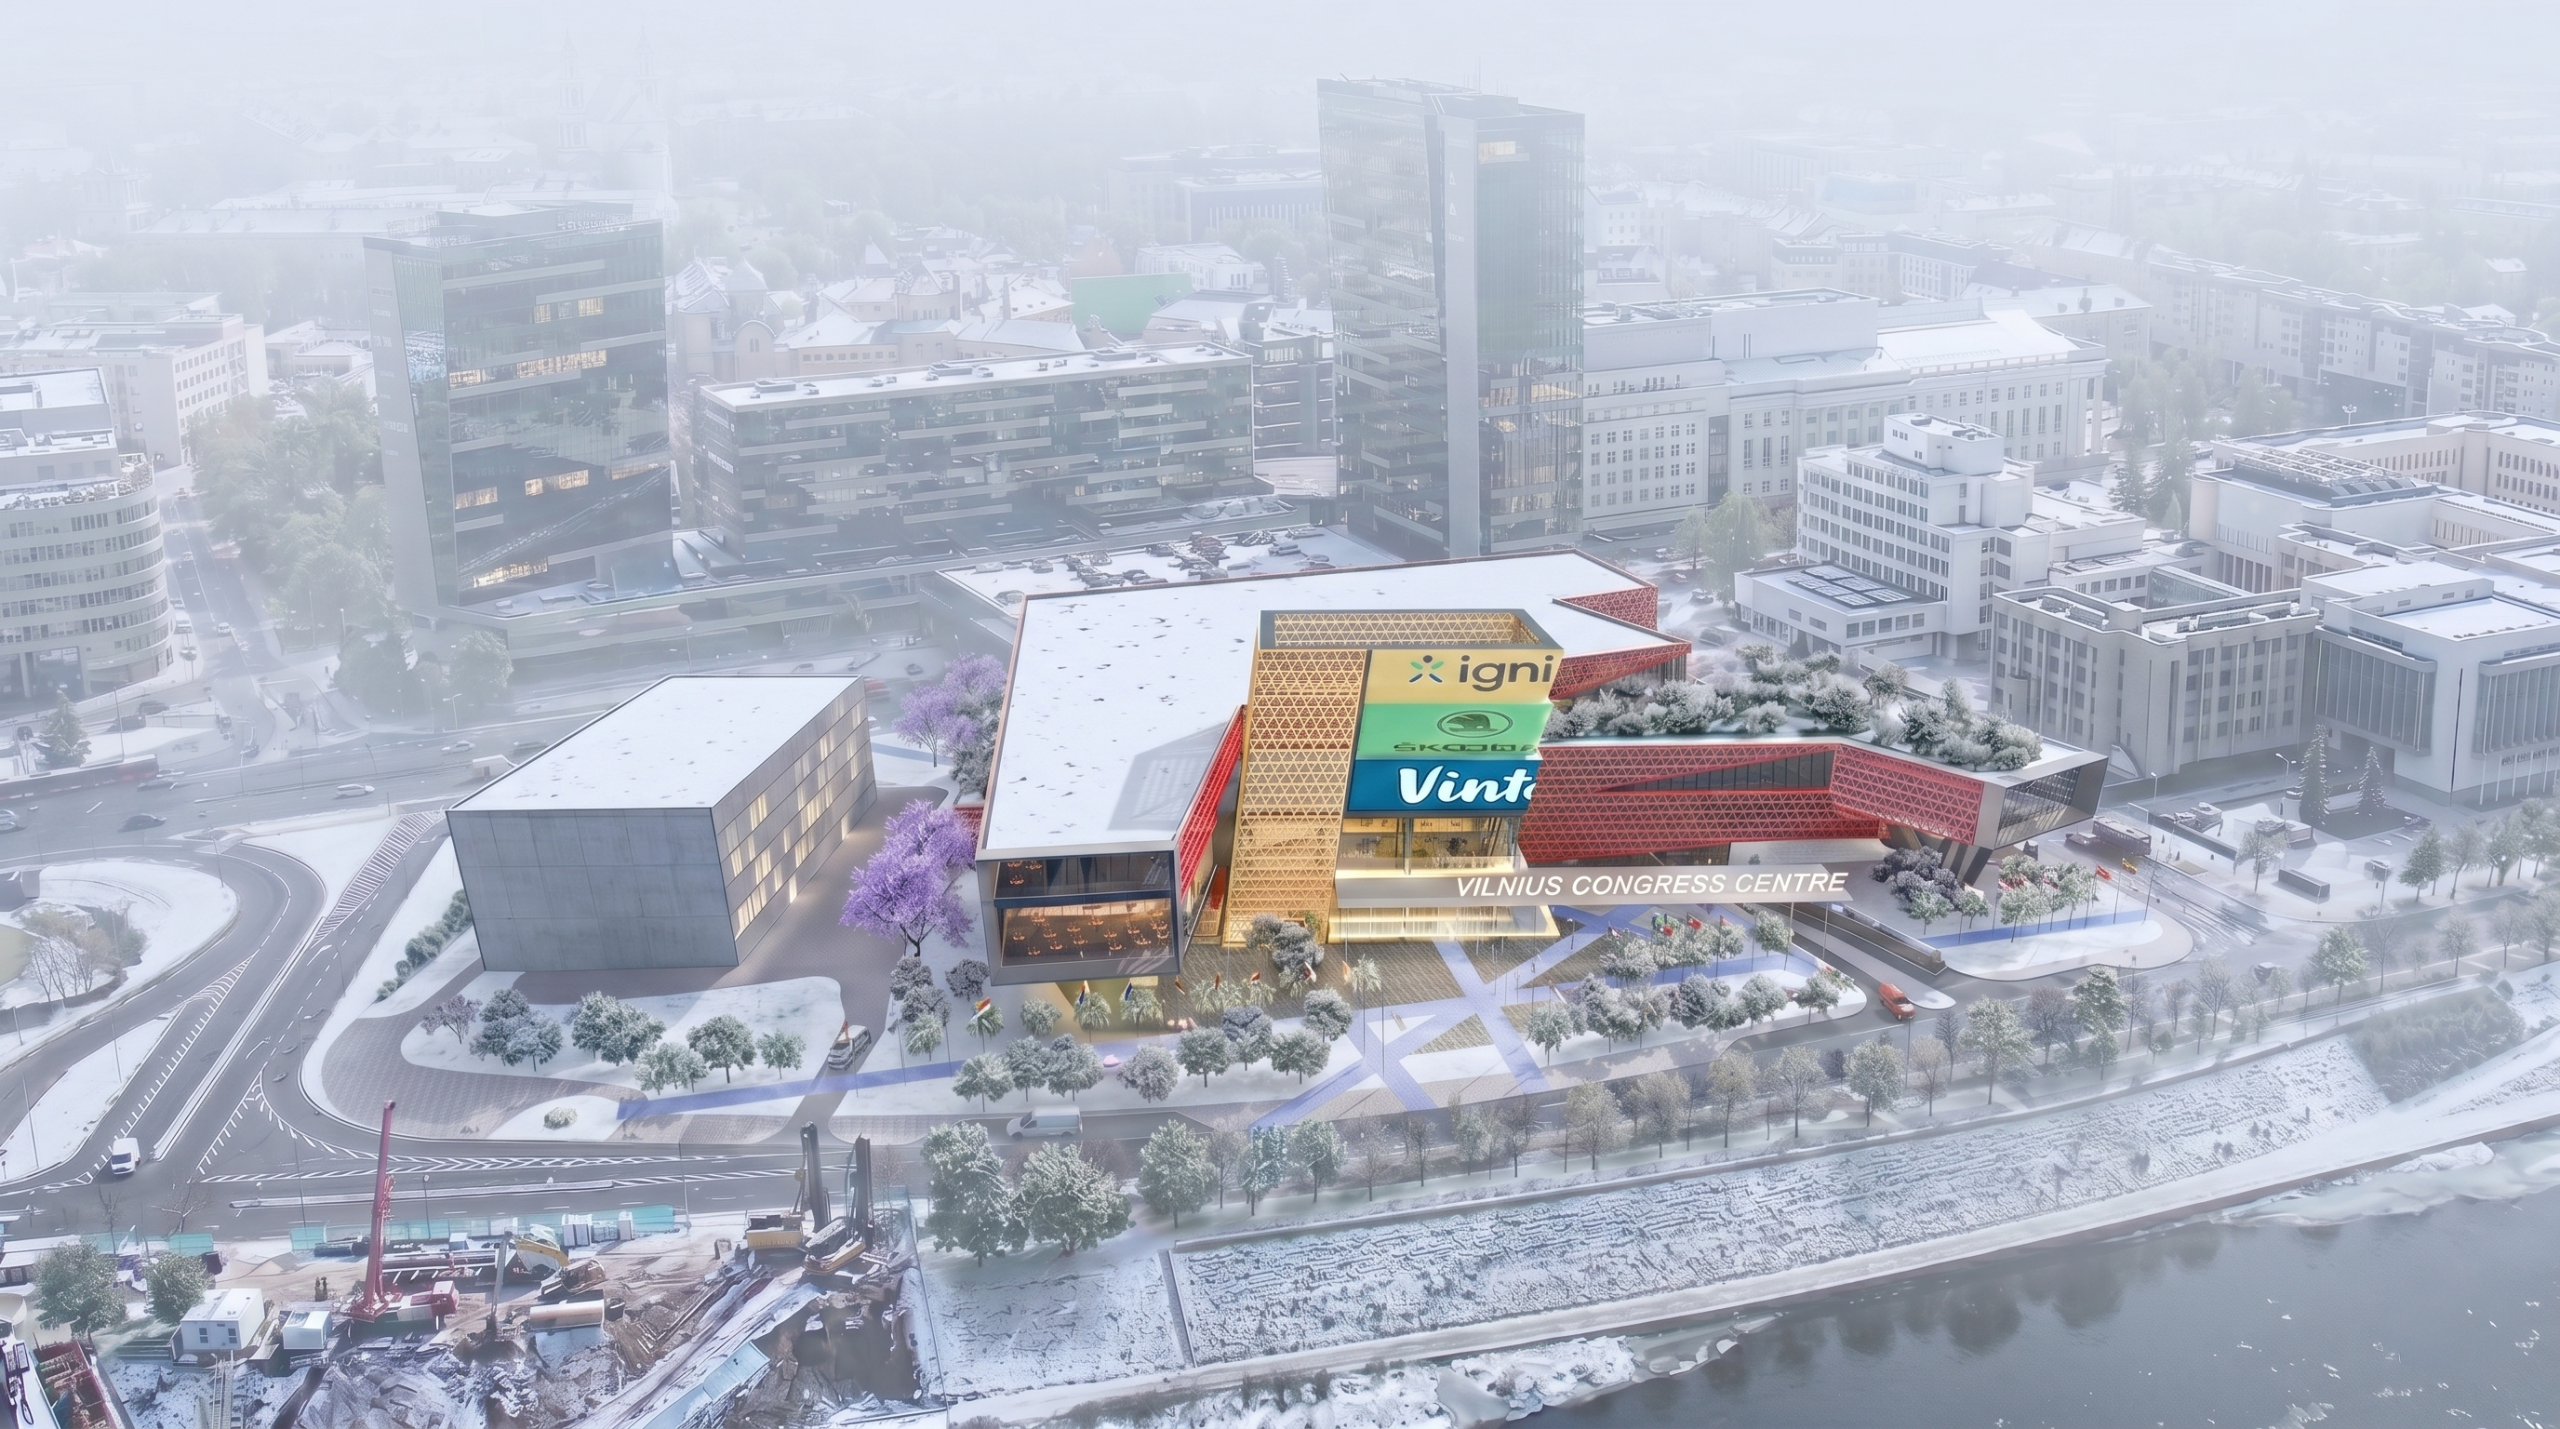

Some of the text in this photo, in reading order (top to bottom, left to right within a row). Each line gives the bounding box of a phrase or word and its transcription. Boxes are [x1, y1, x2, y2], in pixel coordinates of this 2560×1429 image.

[1457, 872, 1849, 897] VILNIUS CONGRESS CENTRE
